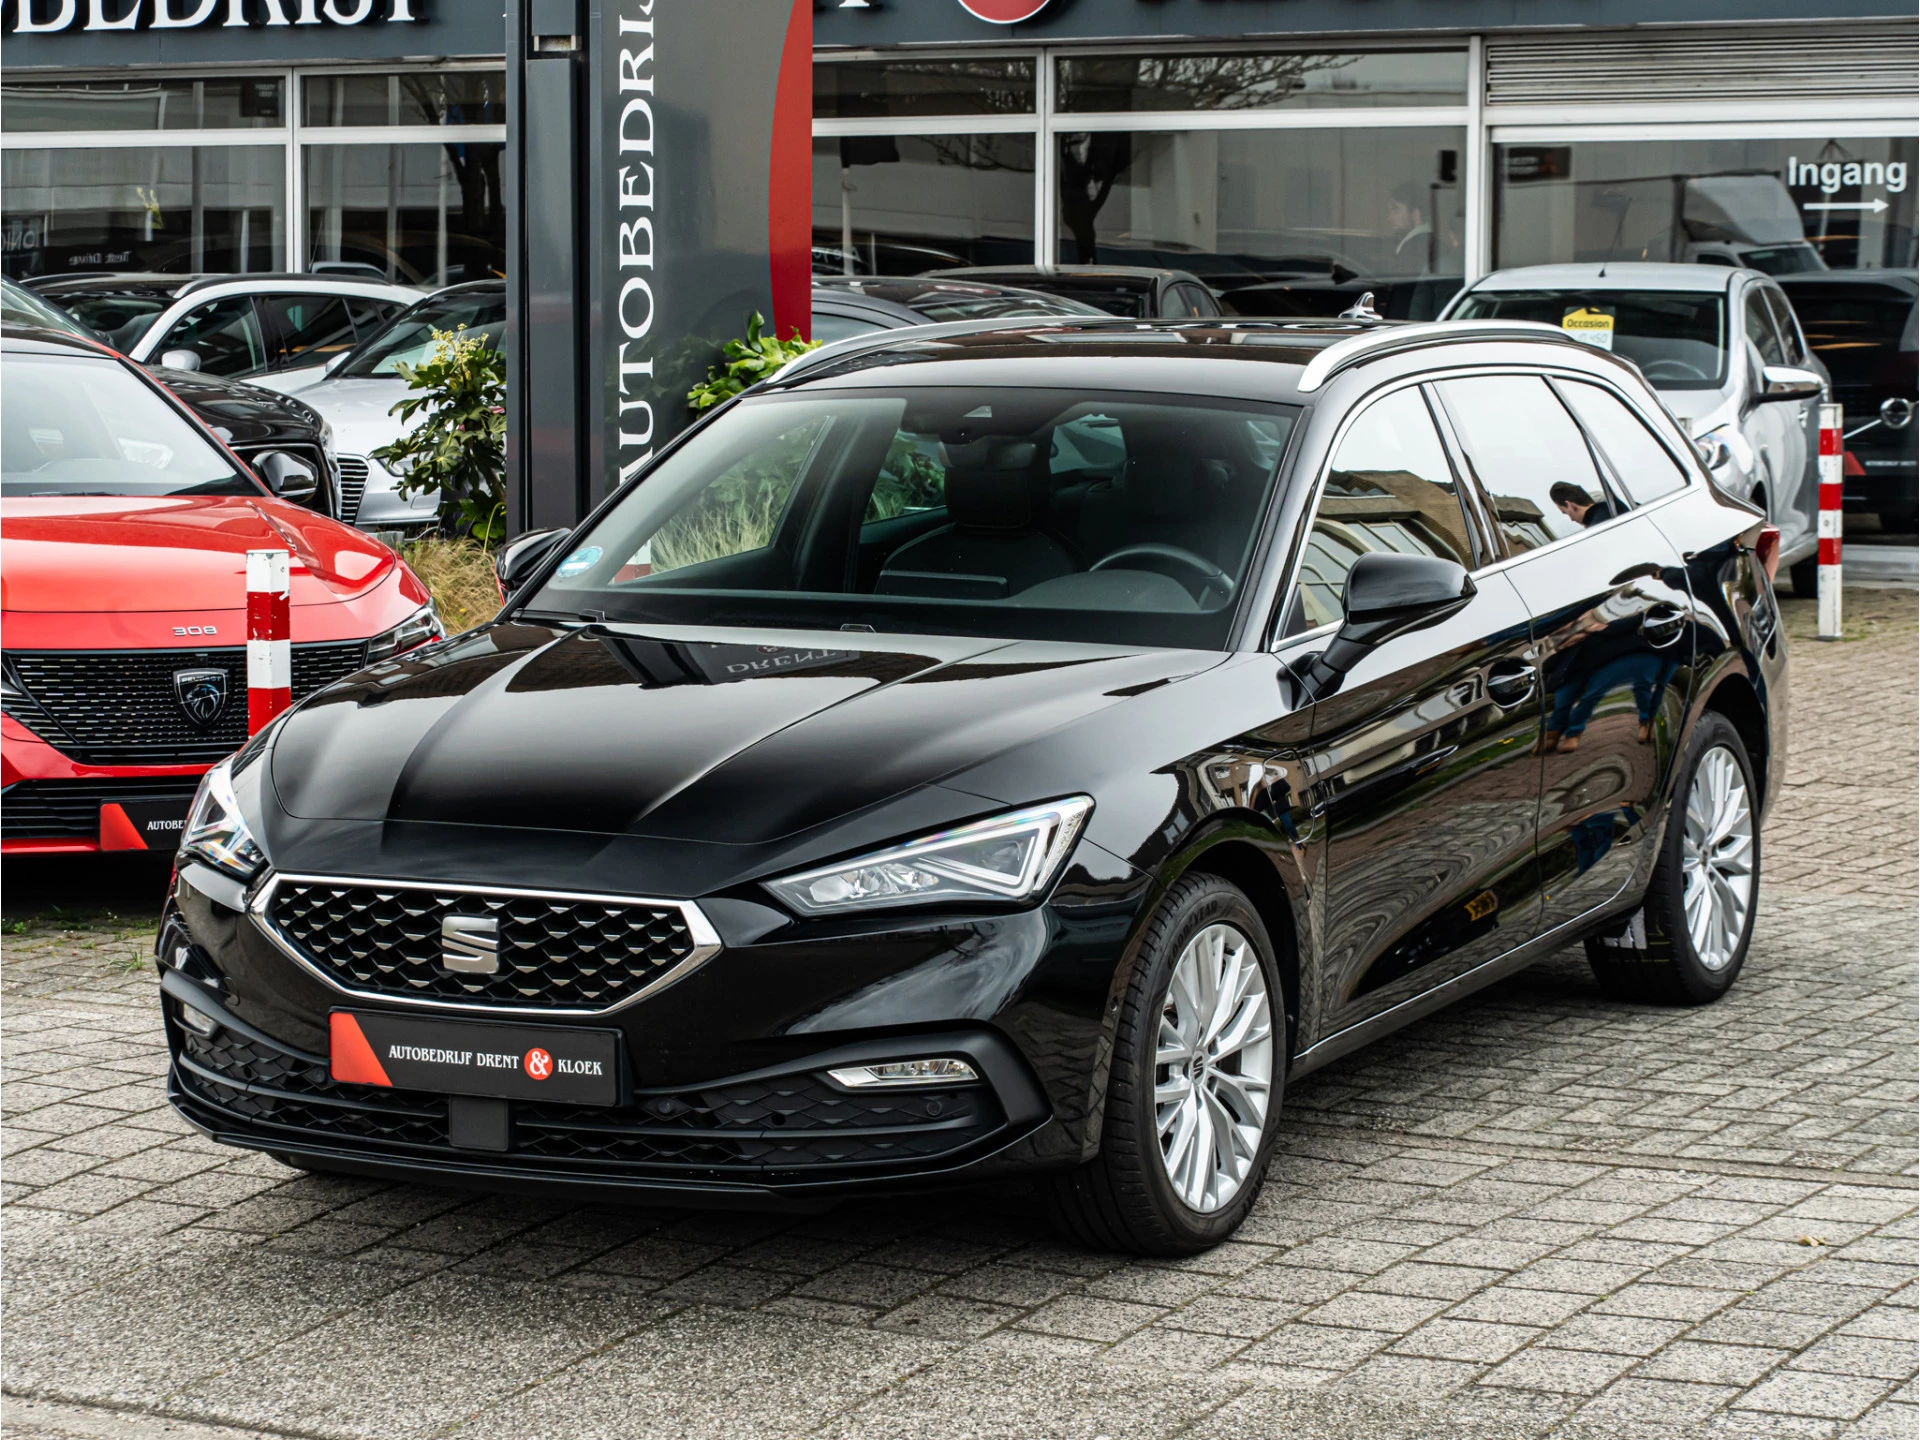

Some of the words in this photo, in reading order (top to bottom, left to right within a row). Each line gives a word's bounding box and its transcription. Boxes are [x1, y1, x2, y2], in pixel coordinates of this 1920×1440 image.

[1788, 156, 1907, 194] Ingang
[1566, 318, 1610, 328] Occasion
[172, 626, 217, 636] 308
[388, 1045, 473, 1066] AUTOBEDRIJF
[476, 1052, 520, 1070] DRENT
[529, 1050, 550, 1076] &
[557, 1059, 604, 1076] KLOEK
